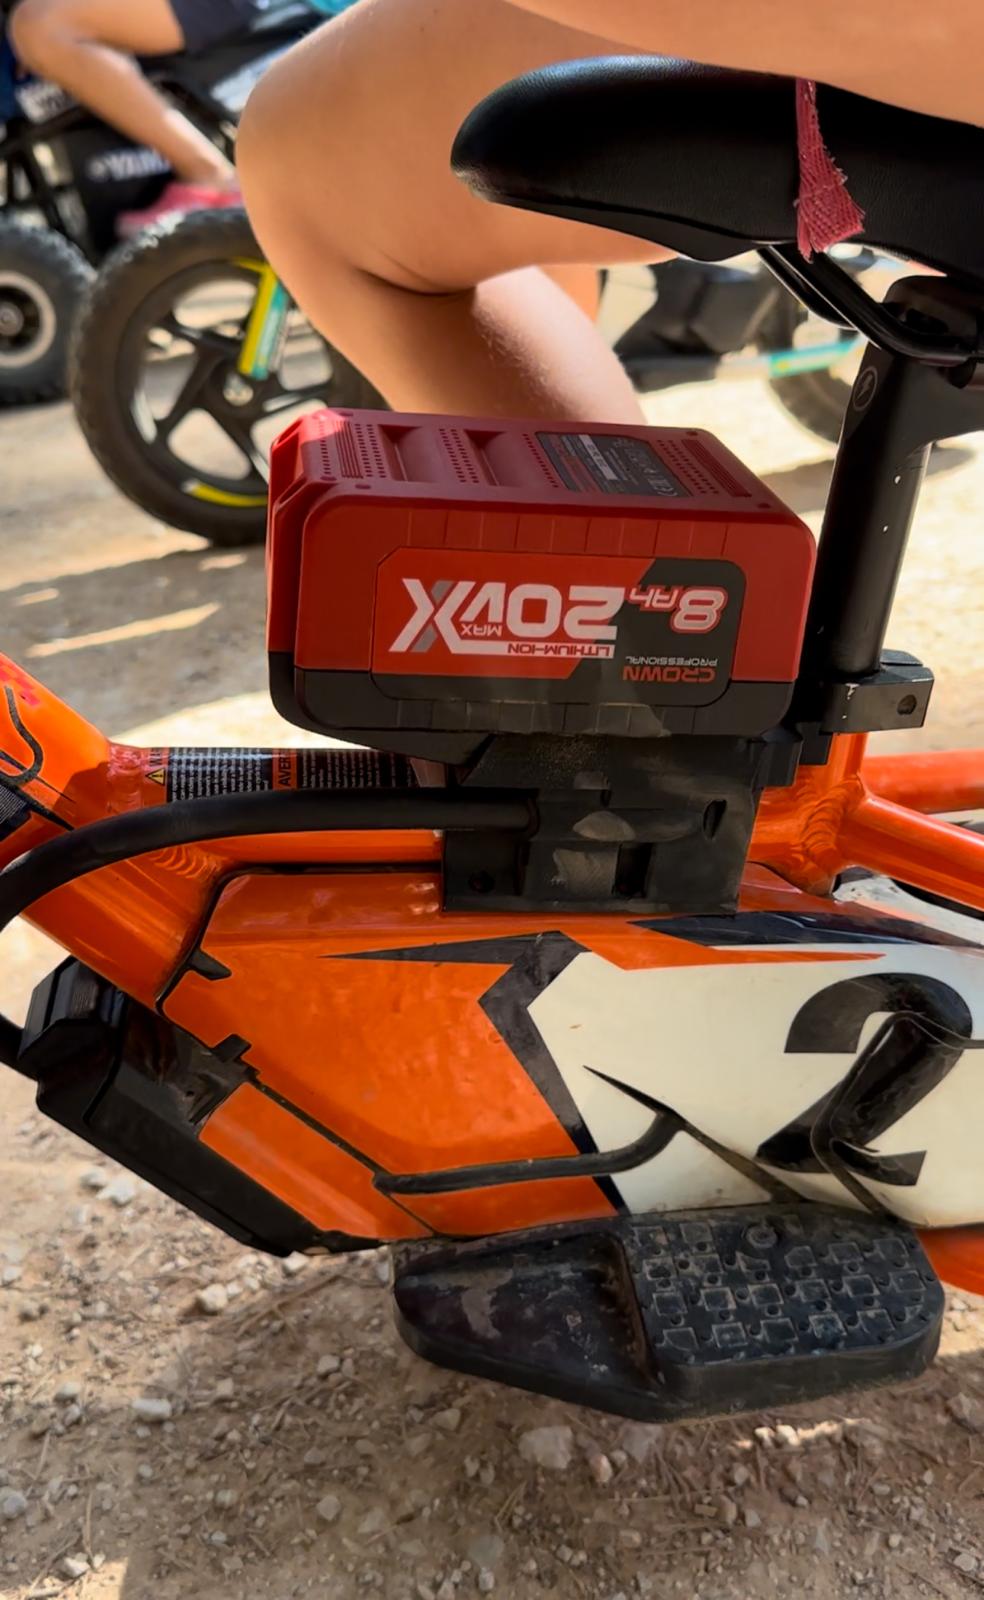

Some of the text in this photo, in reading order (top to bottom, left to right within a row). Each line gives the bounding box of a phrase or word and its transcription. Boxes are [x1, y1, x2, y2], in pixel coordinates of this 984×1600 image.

[460, 622, 503, 637] MAX
[507, 641, 611, 657] LITHIUM-ION
[625, 655, 718, 668] PROFESSIONAL
[622, 664, 717, 683] CROWN
[753, 972, 973, 1187] 2
